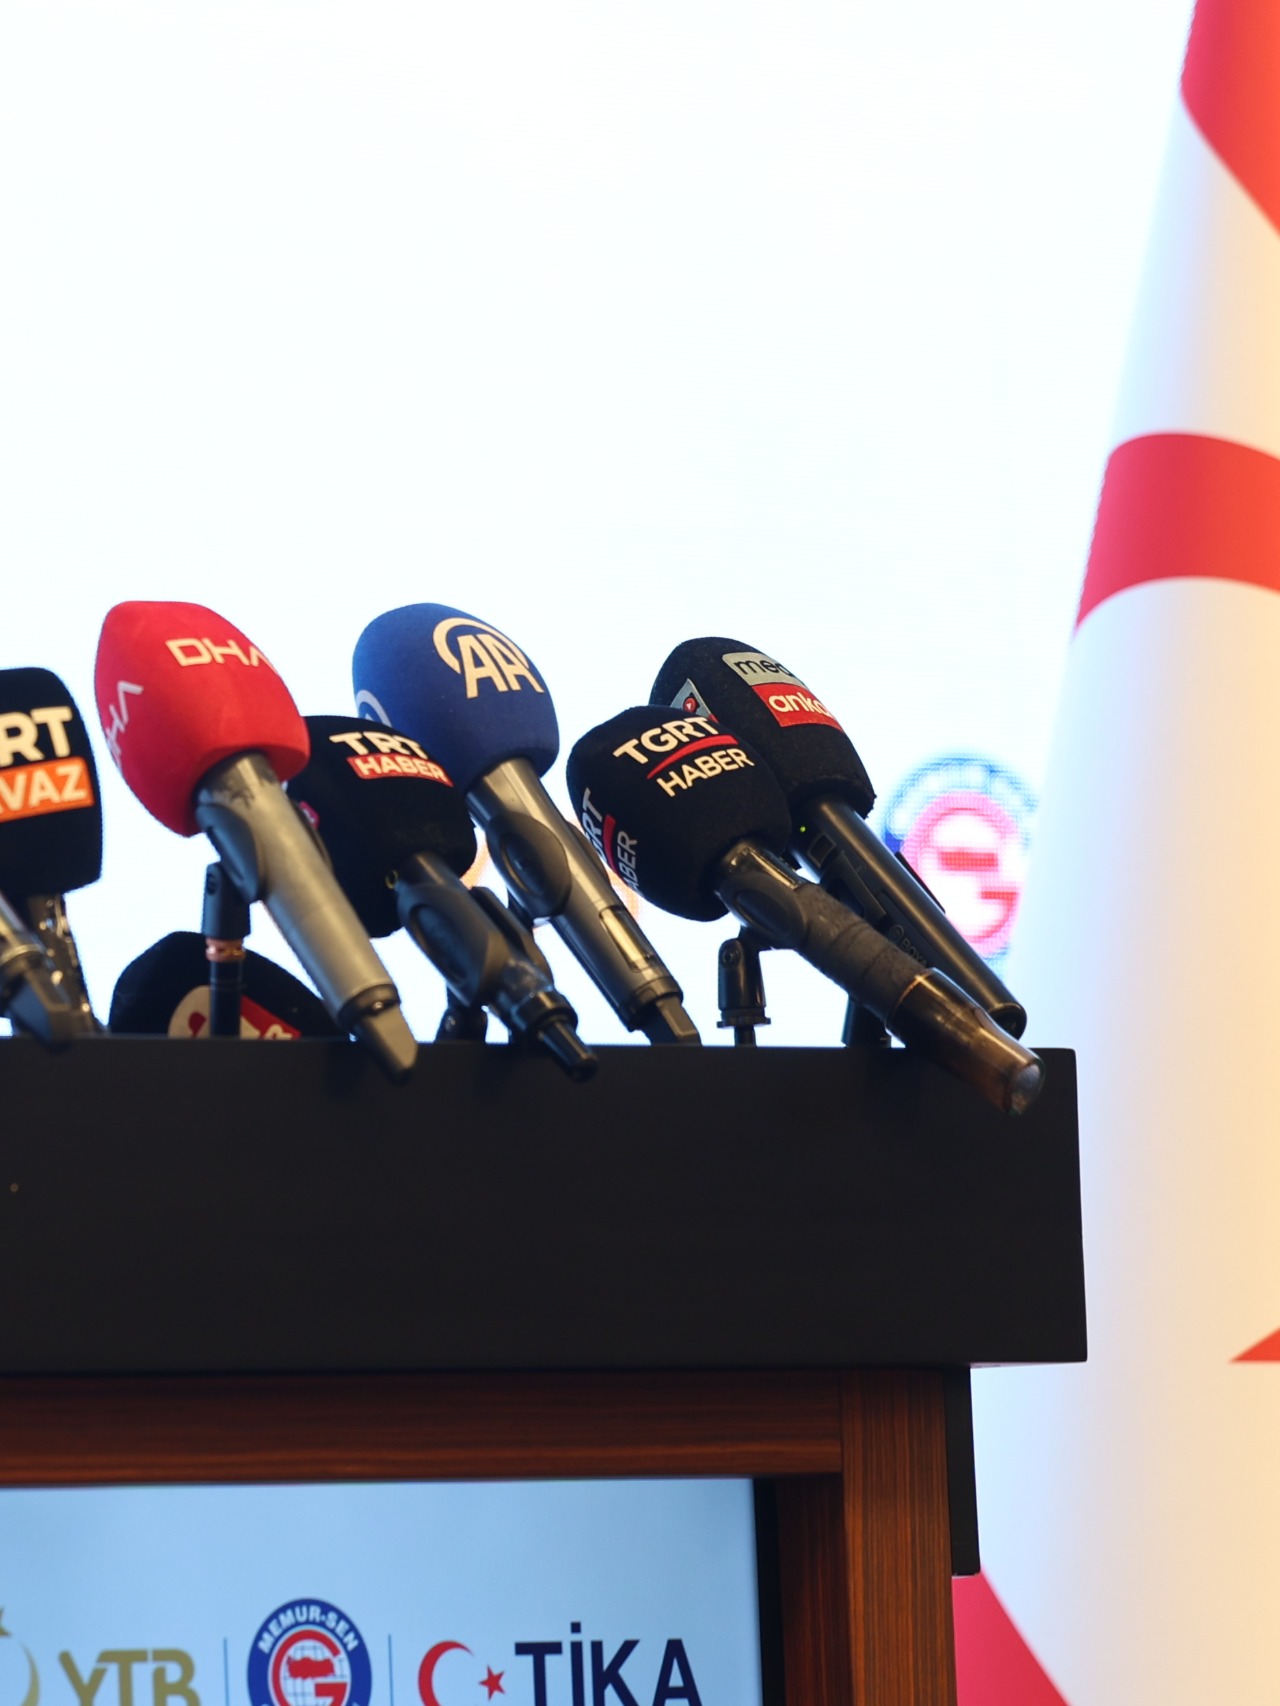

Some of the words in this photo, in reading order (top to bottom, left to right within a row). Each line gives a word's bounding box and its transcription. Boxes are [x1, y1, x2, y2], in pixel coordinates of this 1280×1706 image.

[457, 633, 544, 699] AA
[329, 731, 429, 760] TRT
[612, 716, 719, 765] TGRT
[354, 756, 449, 784] HABER
[656, 748, 755, 798] HABER
[257, 1604, 359, 1654] MEMUR-SEN
[58, 1648, 202, 1706] YTB
[514, 1620, 704, 1706] TİKA
